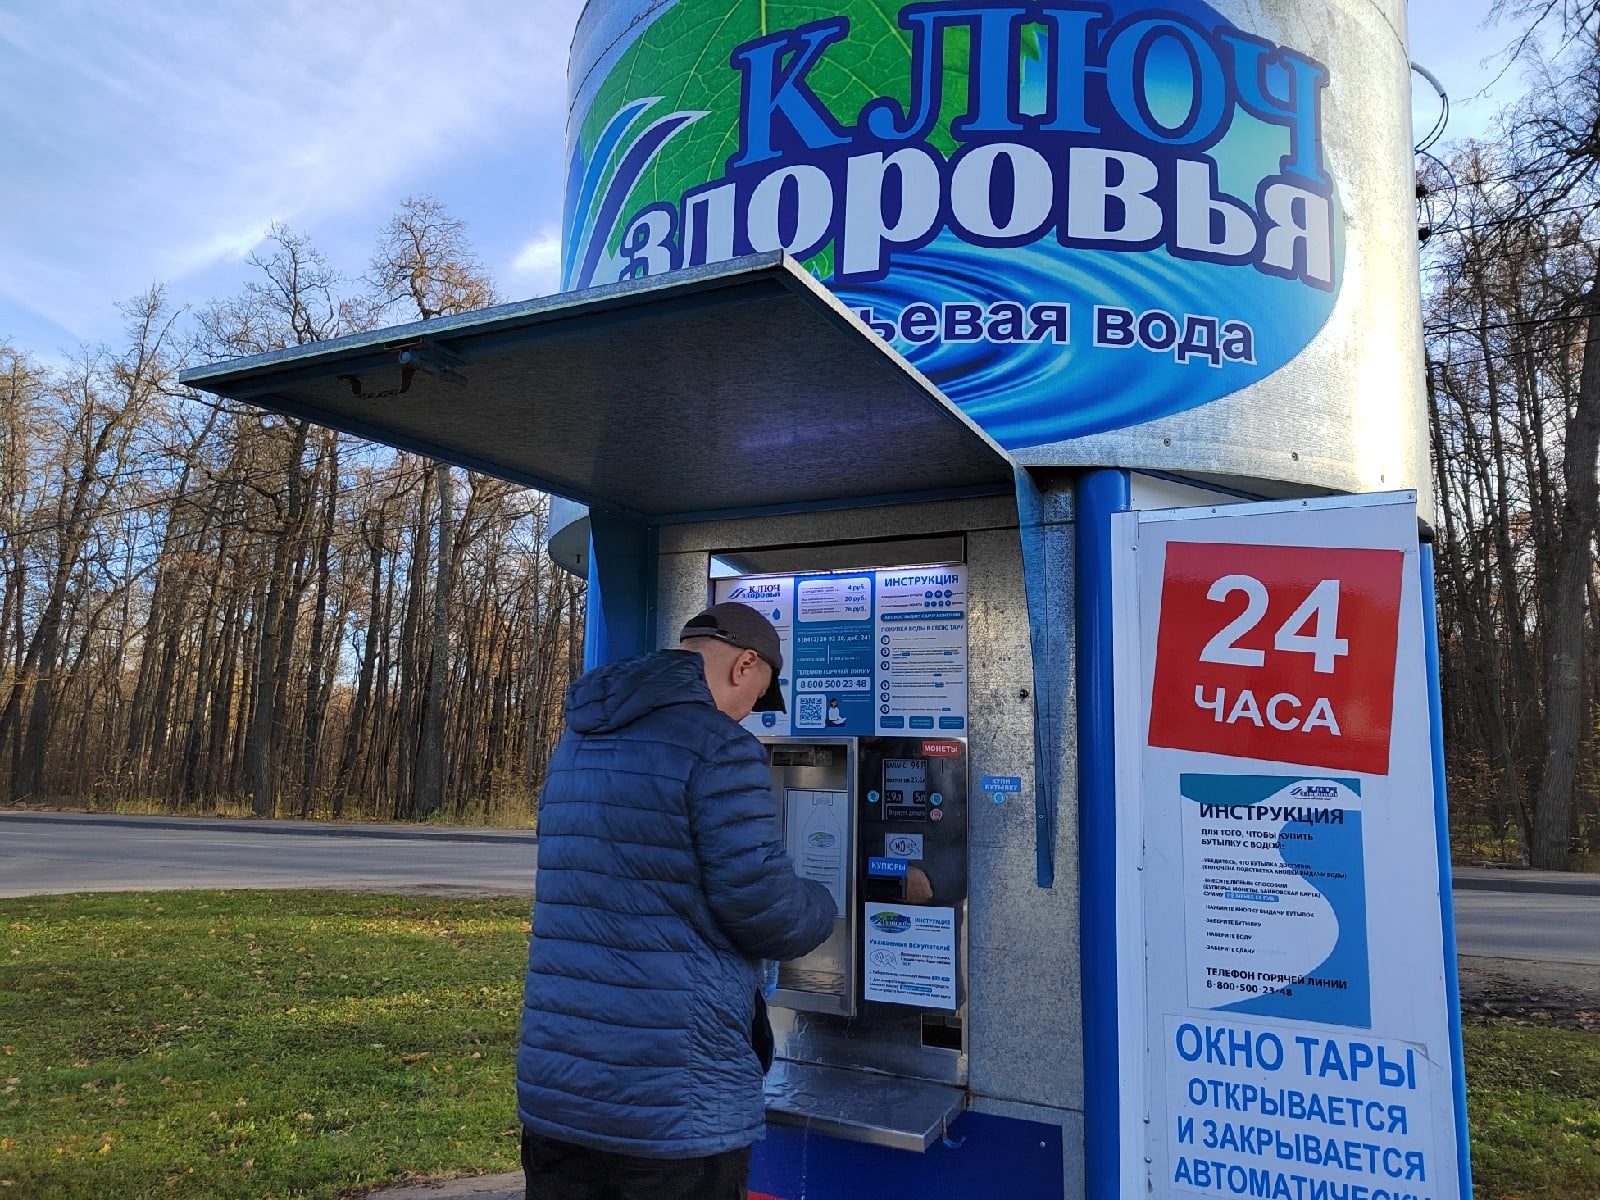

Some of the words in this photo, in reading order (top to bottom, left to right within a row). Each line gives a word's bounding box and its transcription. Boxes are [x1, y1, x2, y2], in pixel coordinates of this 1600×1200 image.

[733, 3, 1329, 186] КЛЮЧ
[857, 301, 1070, 345] ьевая
[1095, 305, 1257, 367] вода
[884, 574, 959, 587] ИНСТРУКЦИЯ
[1199, 574, 1349, 673] 24
[1194, 685, 1341, 736] ЧАСА
[924, 745, 958, 753] МОНЕТЫ
[1199, 803, 1344, 826] ИНСТРУКЦИЯ
[1201, 828, 1219, 836] ДЛЯ
[1220, 829, 1244, 839] ТОГО,
[1246, 830, 1277, 839] ЧТОБЫ
[1278, 832, 1314, 841] КУПИТЬ
[1201, 839, 1241, 848] БУТЫЛКУ
[1242, 840, 1249, 848] С
[871, 861, 906, 871] КУПЮРЫ
[1206, 967, 1255, 981] ТЕЛЕФОН
[1257, 972, 1305, 985] ГОРЯЧЕЙ
[1306, 977, 1348, 989] ЛИНИИ
[1176, 1023, 1284, 1071] ОКНО
[1295, 1035, 1416, 1090] ТАРЫ
[1188, 1077, 1408, 1135] ОТКРЫВАЕТСЯ
[1177, 1115, 1194, 1145] И
[1202, 1119, 1426, 1182] ЗАКРЫВАЕТСЯ
